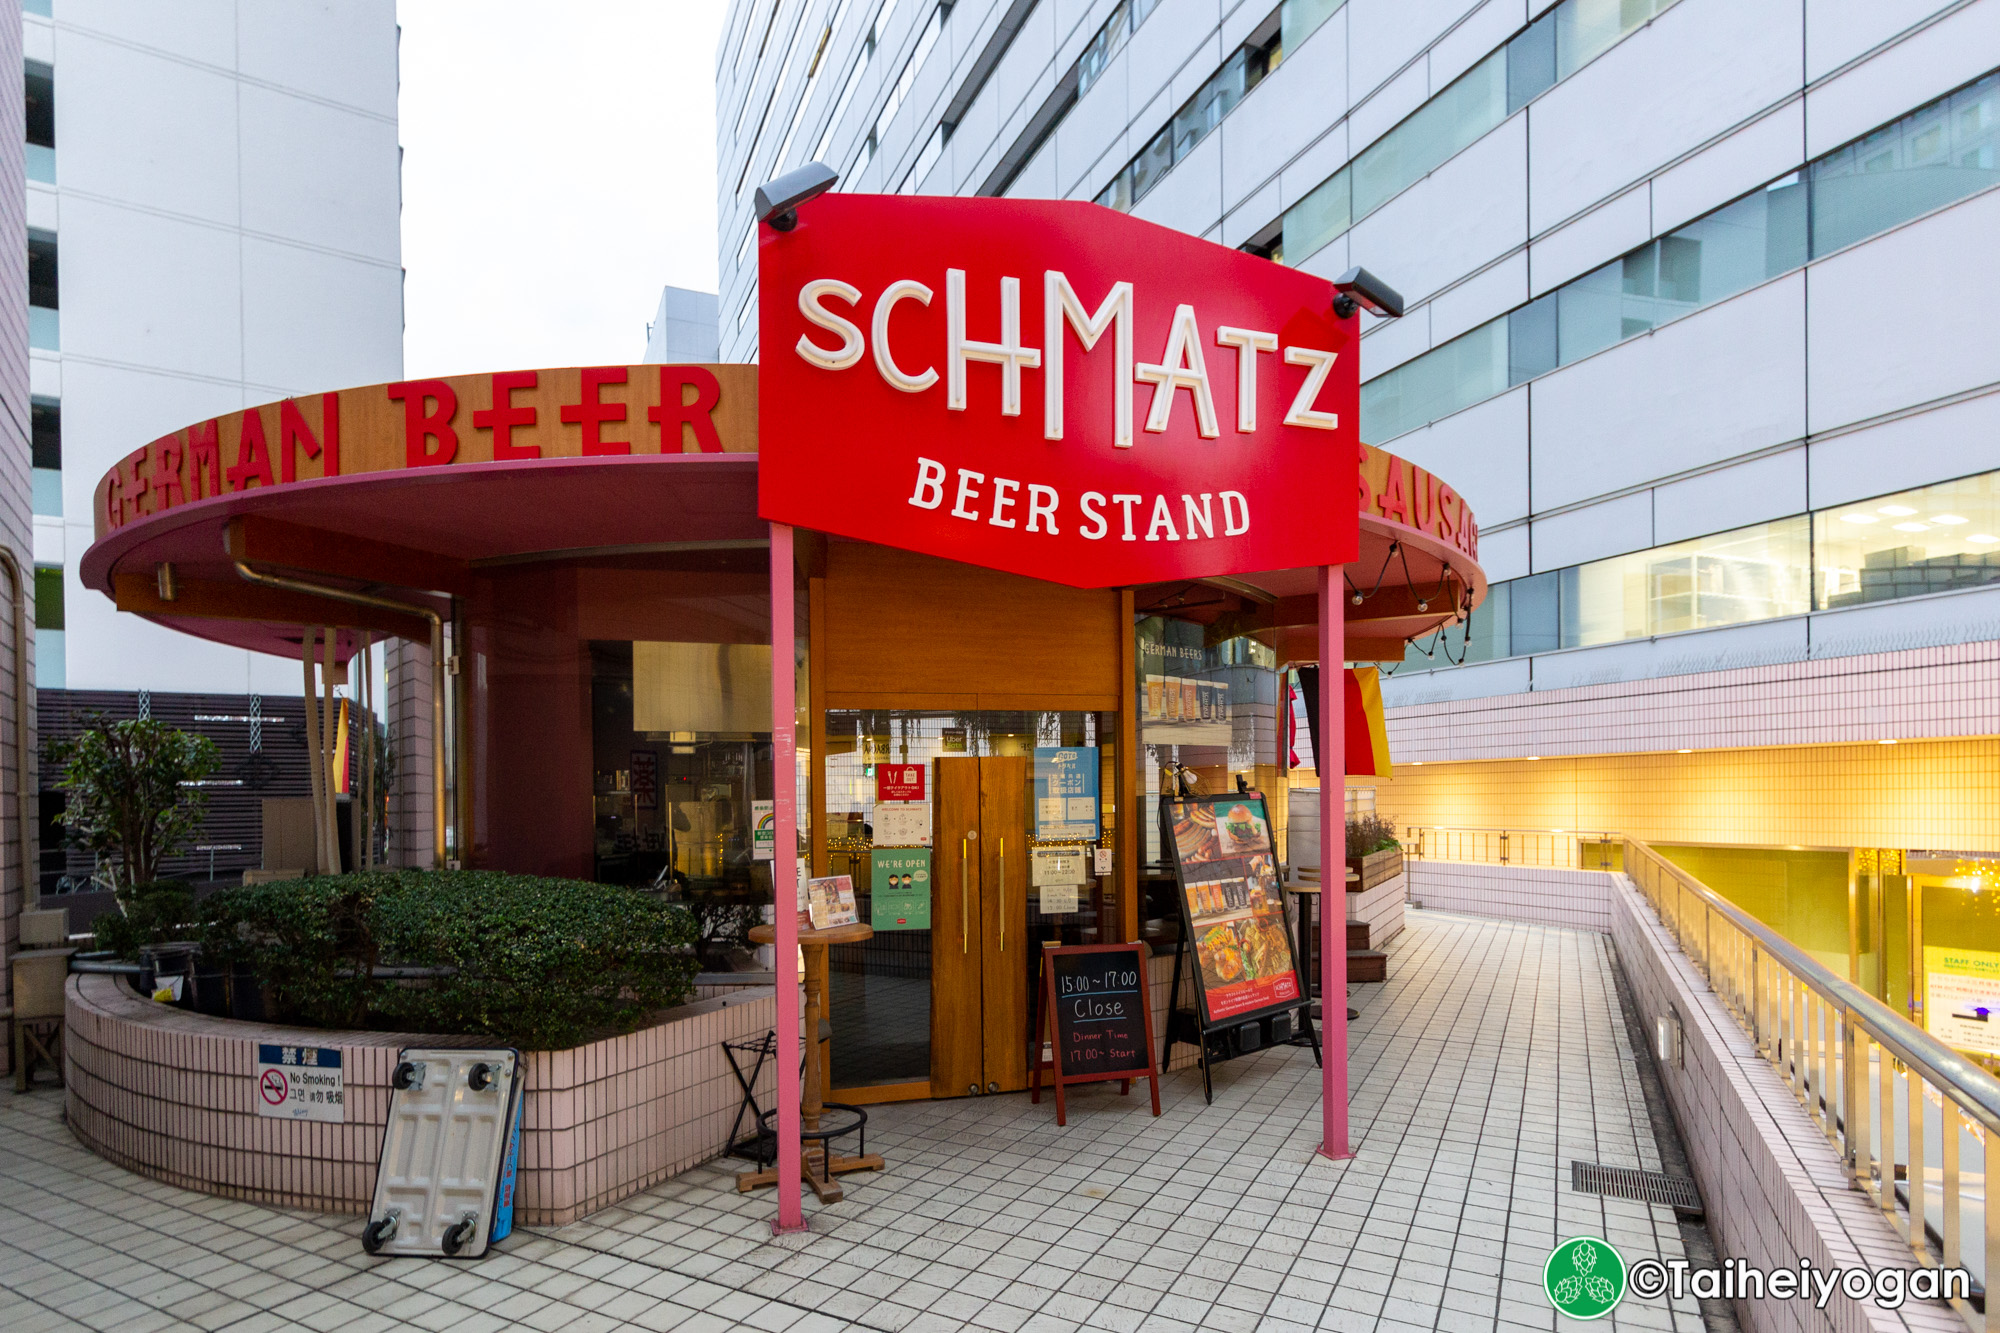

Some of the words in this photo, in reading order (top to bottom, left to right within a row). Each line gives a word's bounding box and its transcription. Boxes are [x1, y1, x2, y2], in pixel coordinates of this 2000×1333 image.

[794, 268, 1339, 448] SCHMATZ
[106, 392, 338, 528] GERMAN
[388, 366, 724, 468] BEER
[908, 456, 1059, 535] BEER
[1078, 490, 1250, 542] STAND
[1144, 643, 1177, 658] GERMAN
[1179, 647, 1203, 660] BEERS
[877, 860, 903, 869] WE'RE
[905, 859, 926, 868] OPEN
[1944, 957, 1969, 965] STAFF
[1973, 960, 1999, 968] ONLY
[1061, 976, 1090, 994] 15:00
[1104, 971, 1137, 988] 17:00
[1074, 999, 1124, 1017] Close
[1073, 1032, 1102, 1043] Dinner
[1106, 1030, 1129, 1039] Time
[1109, 1048, 1136, 1059] Start
[290, 1072, 301, 1084] No
